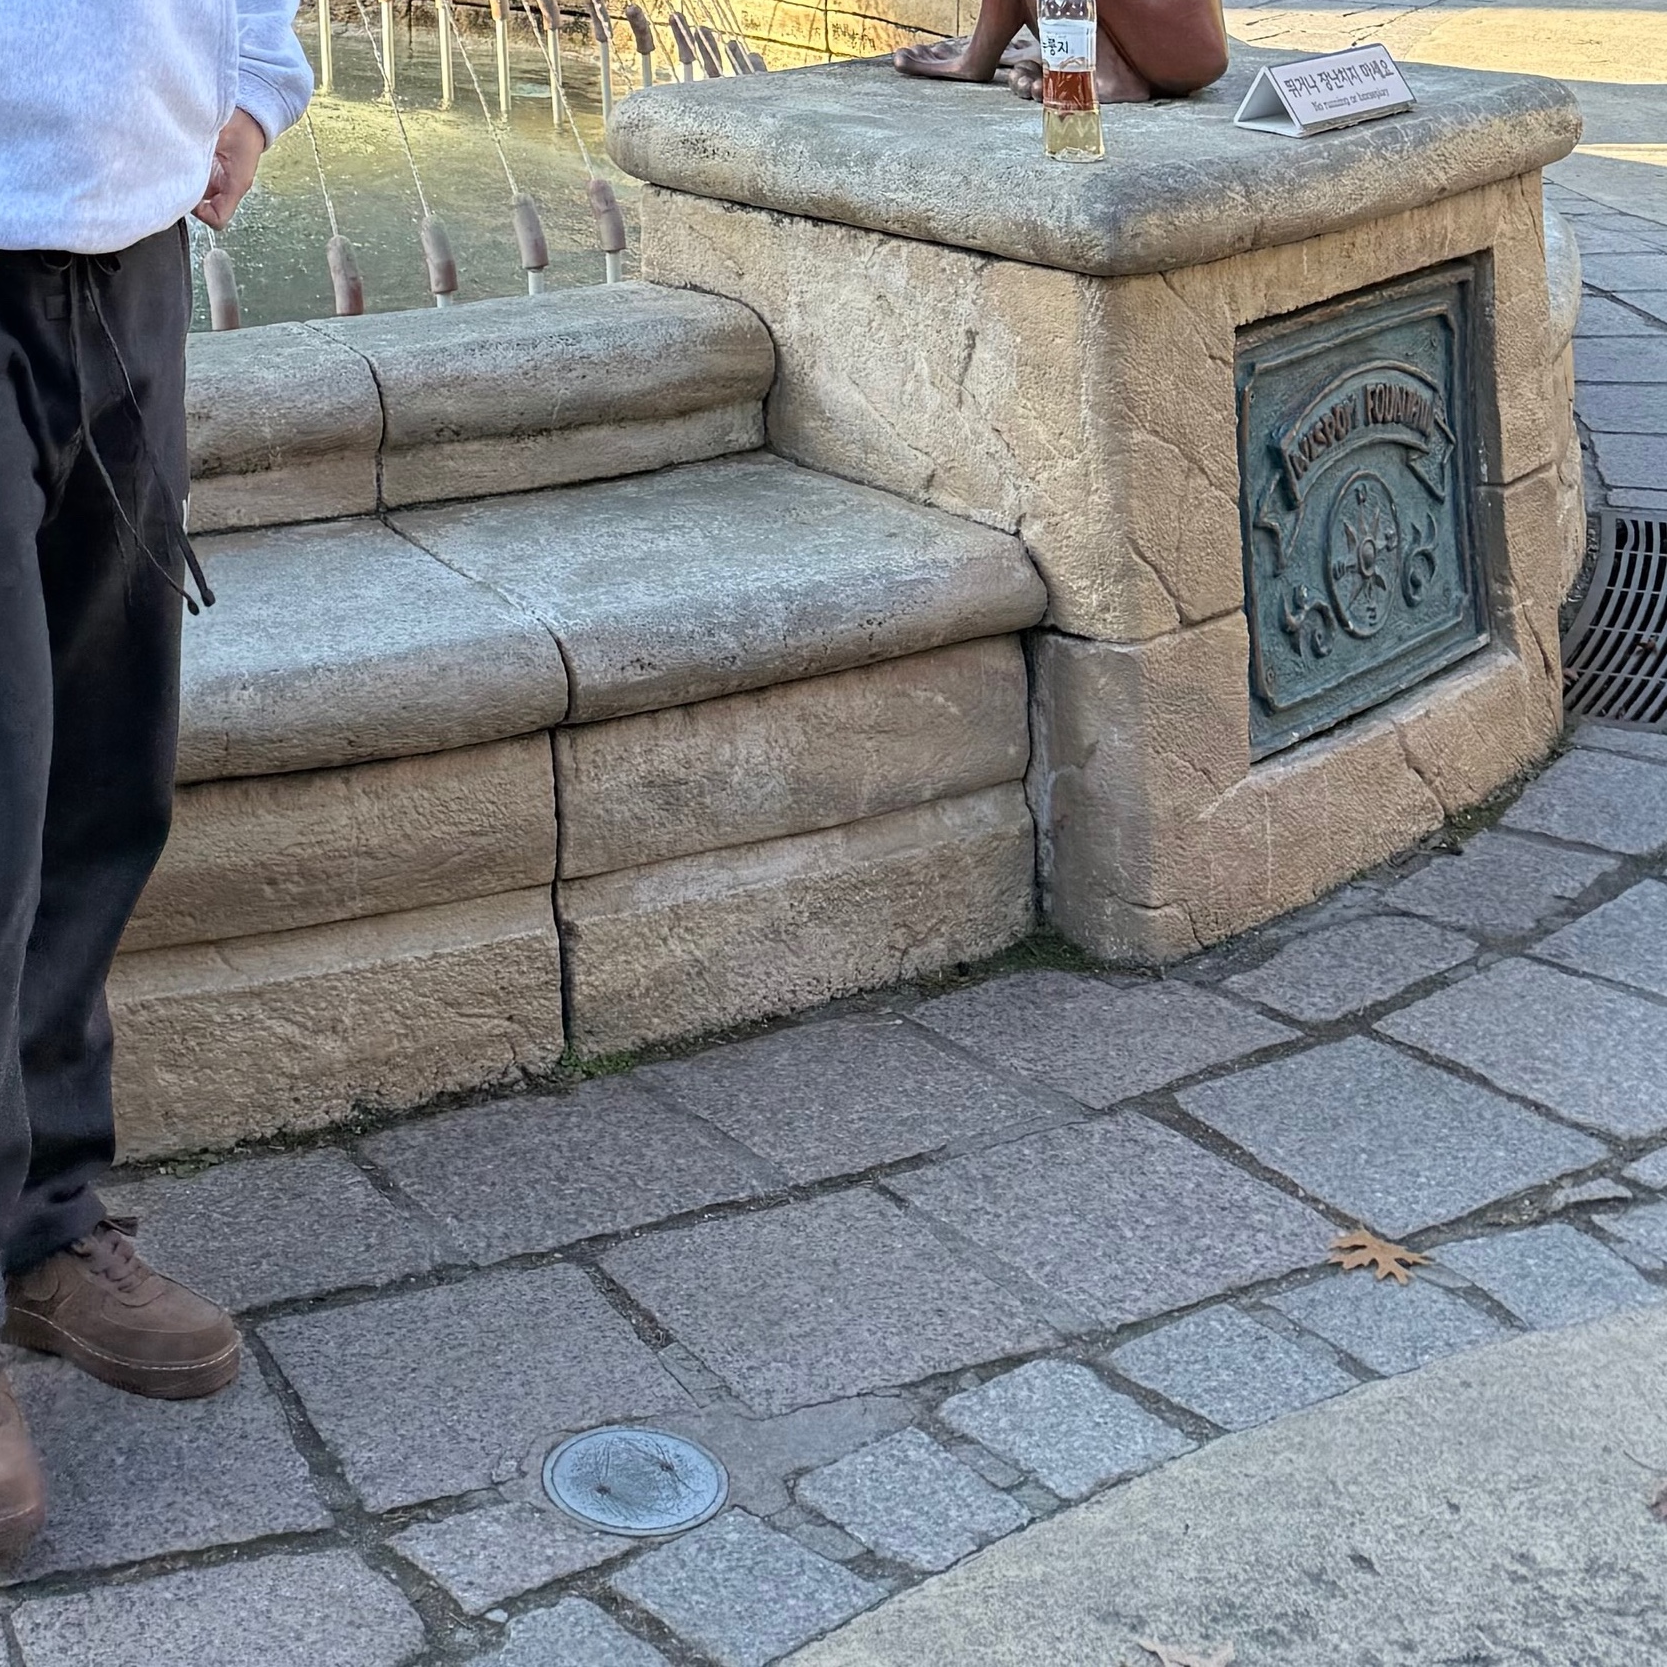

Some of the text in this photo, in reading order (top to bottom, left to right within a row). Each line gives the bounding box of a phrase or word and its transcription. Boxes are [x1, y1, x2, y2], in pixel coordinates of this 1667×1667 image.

[1283, 59, 1395, 98] 뛰거나 장난치지 마세요
[1311, 100, 1324, 111] No
